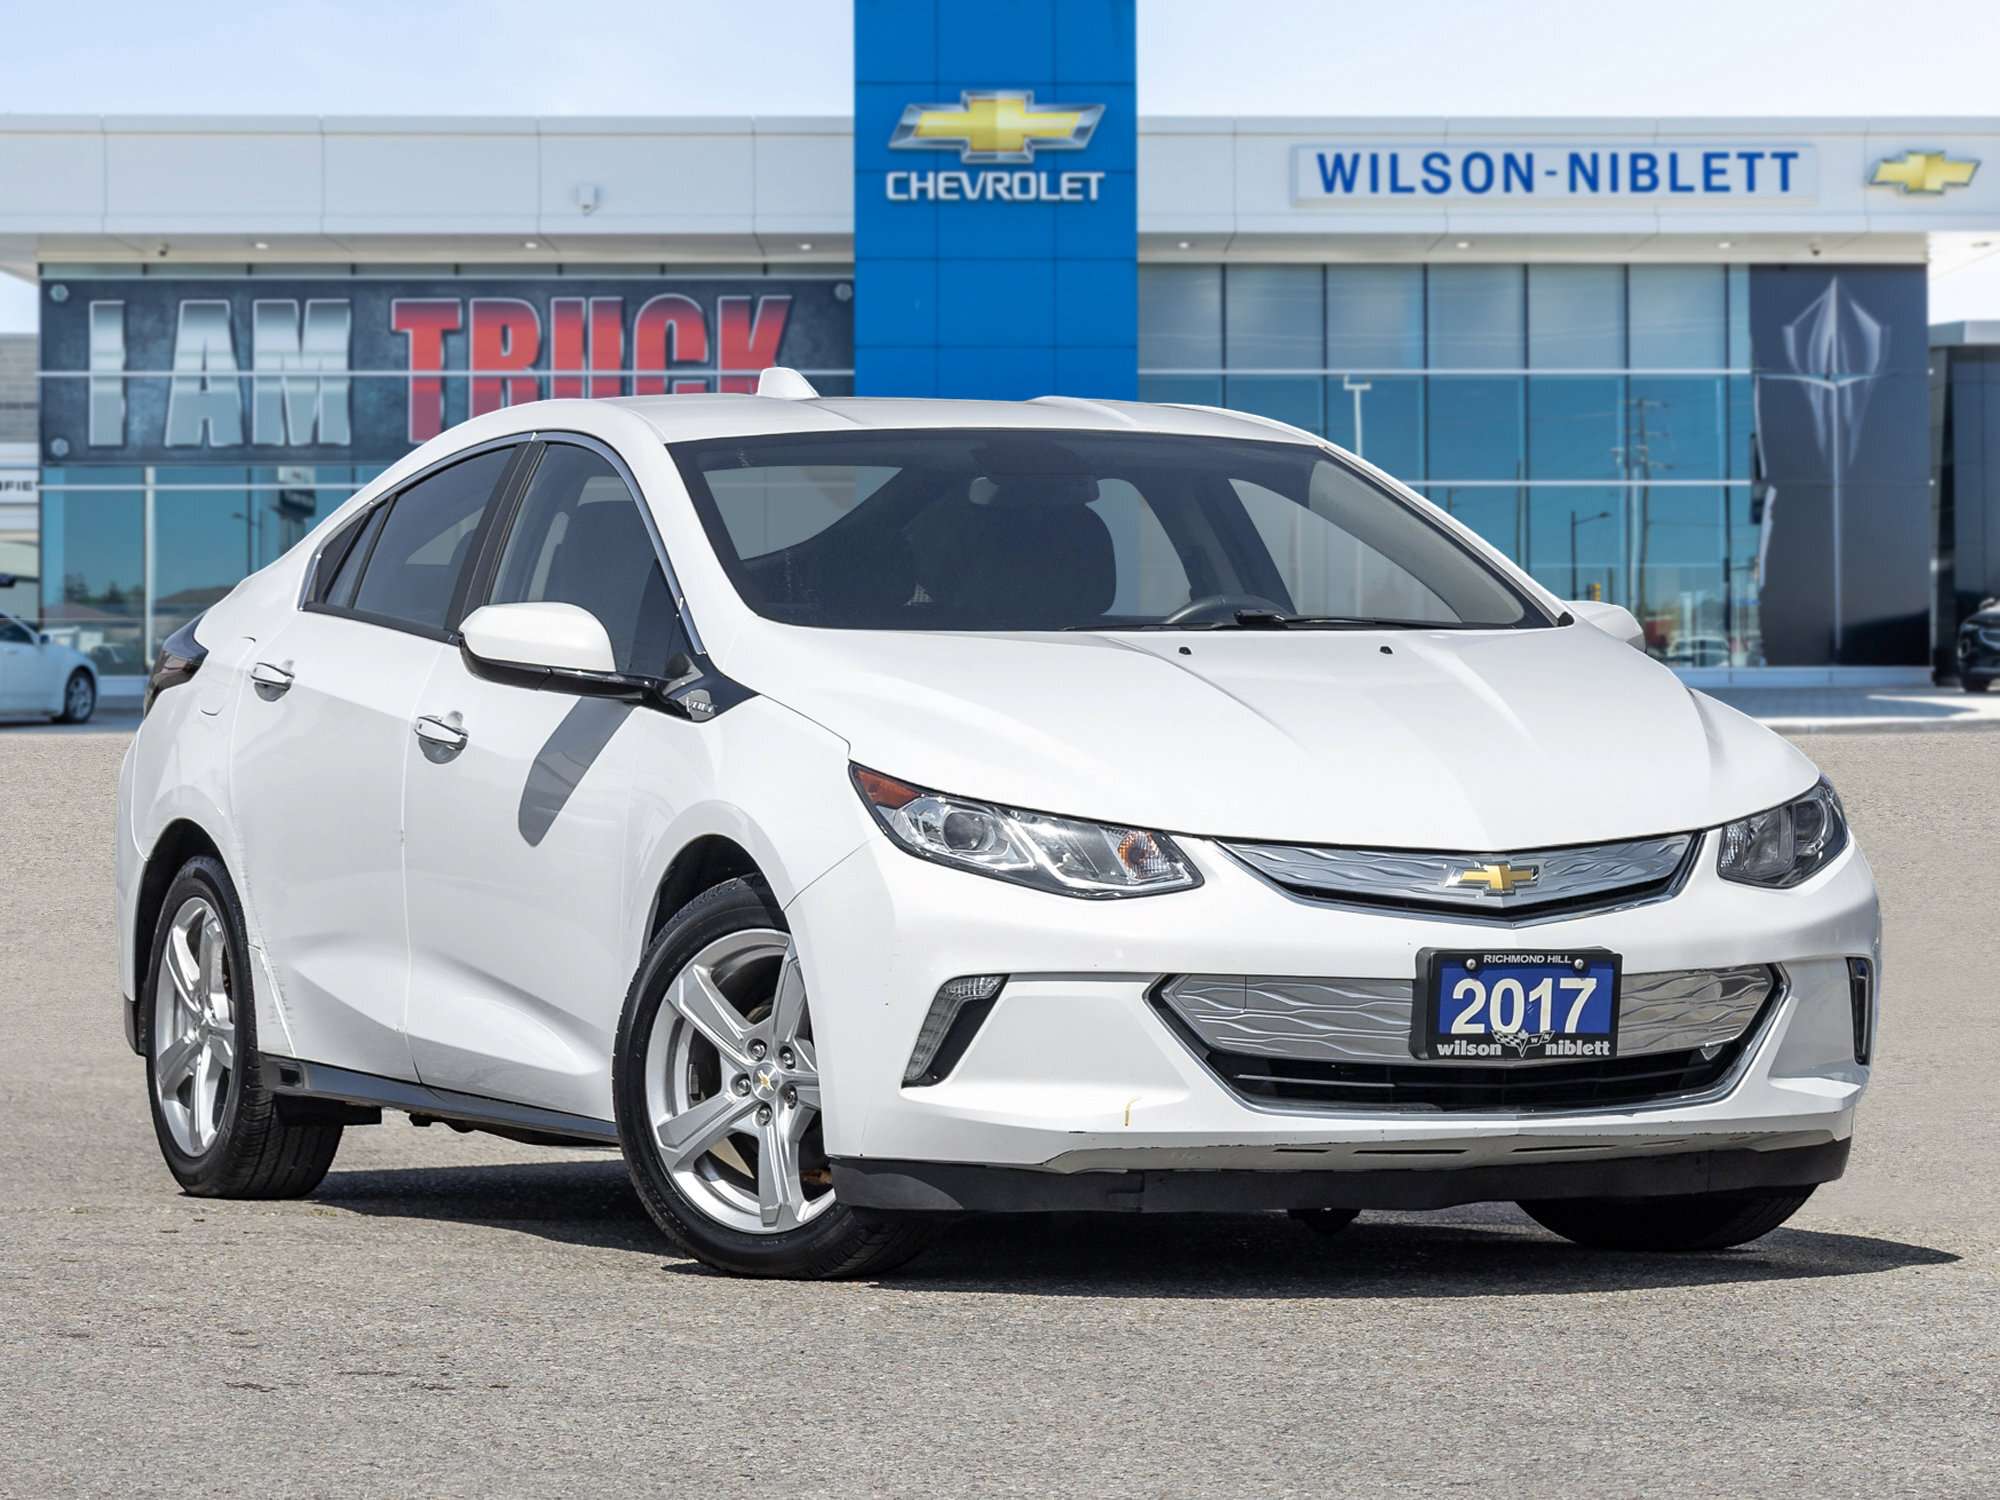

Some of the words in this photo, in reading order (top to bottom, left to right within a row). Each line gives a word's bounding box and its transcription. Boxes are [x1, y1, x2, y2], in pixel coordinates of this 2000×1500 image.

[886, 171, 1105, 201] CHEVROLET
[1316, 152, 1799, 195] WILSON-NIBLETT
[89, 300, 125, 446] I
[165, 299, 351, 447] AM
[391, 293, 792, 444] TRUCK
[1483, 954, 1545, 964] RICHMOND
[1547, 954, 1572, 964] HILL
[1451, 977, 1597, 1034] 2017
[1437, 1040, 1502, 1056] wilson
[1545, 1040, 1610, 1056] niblett
